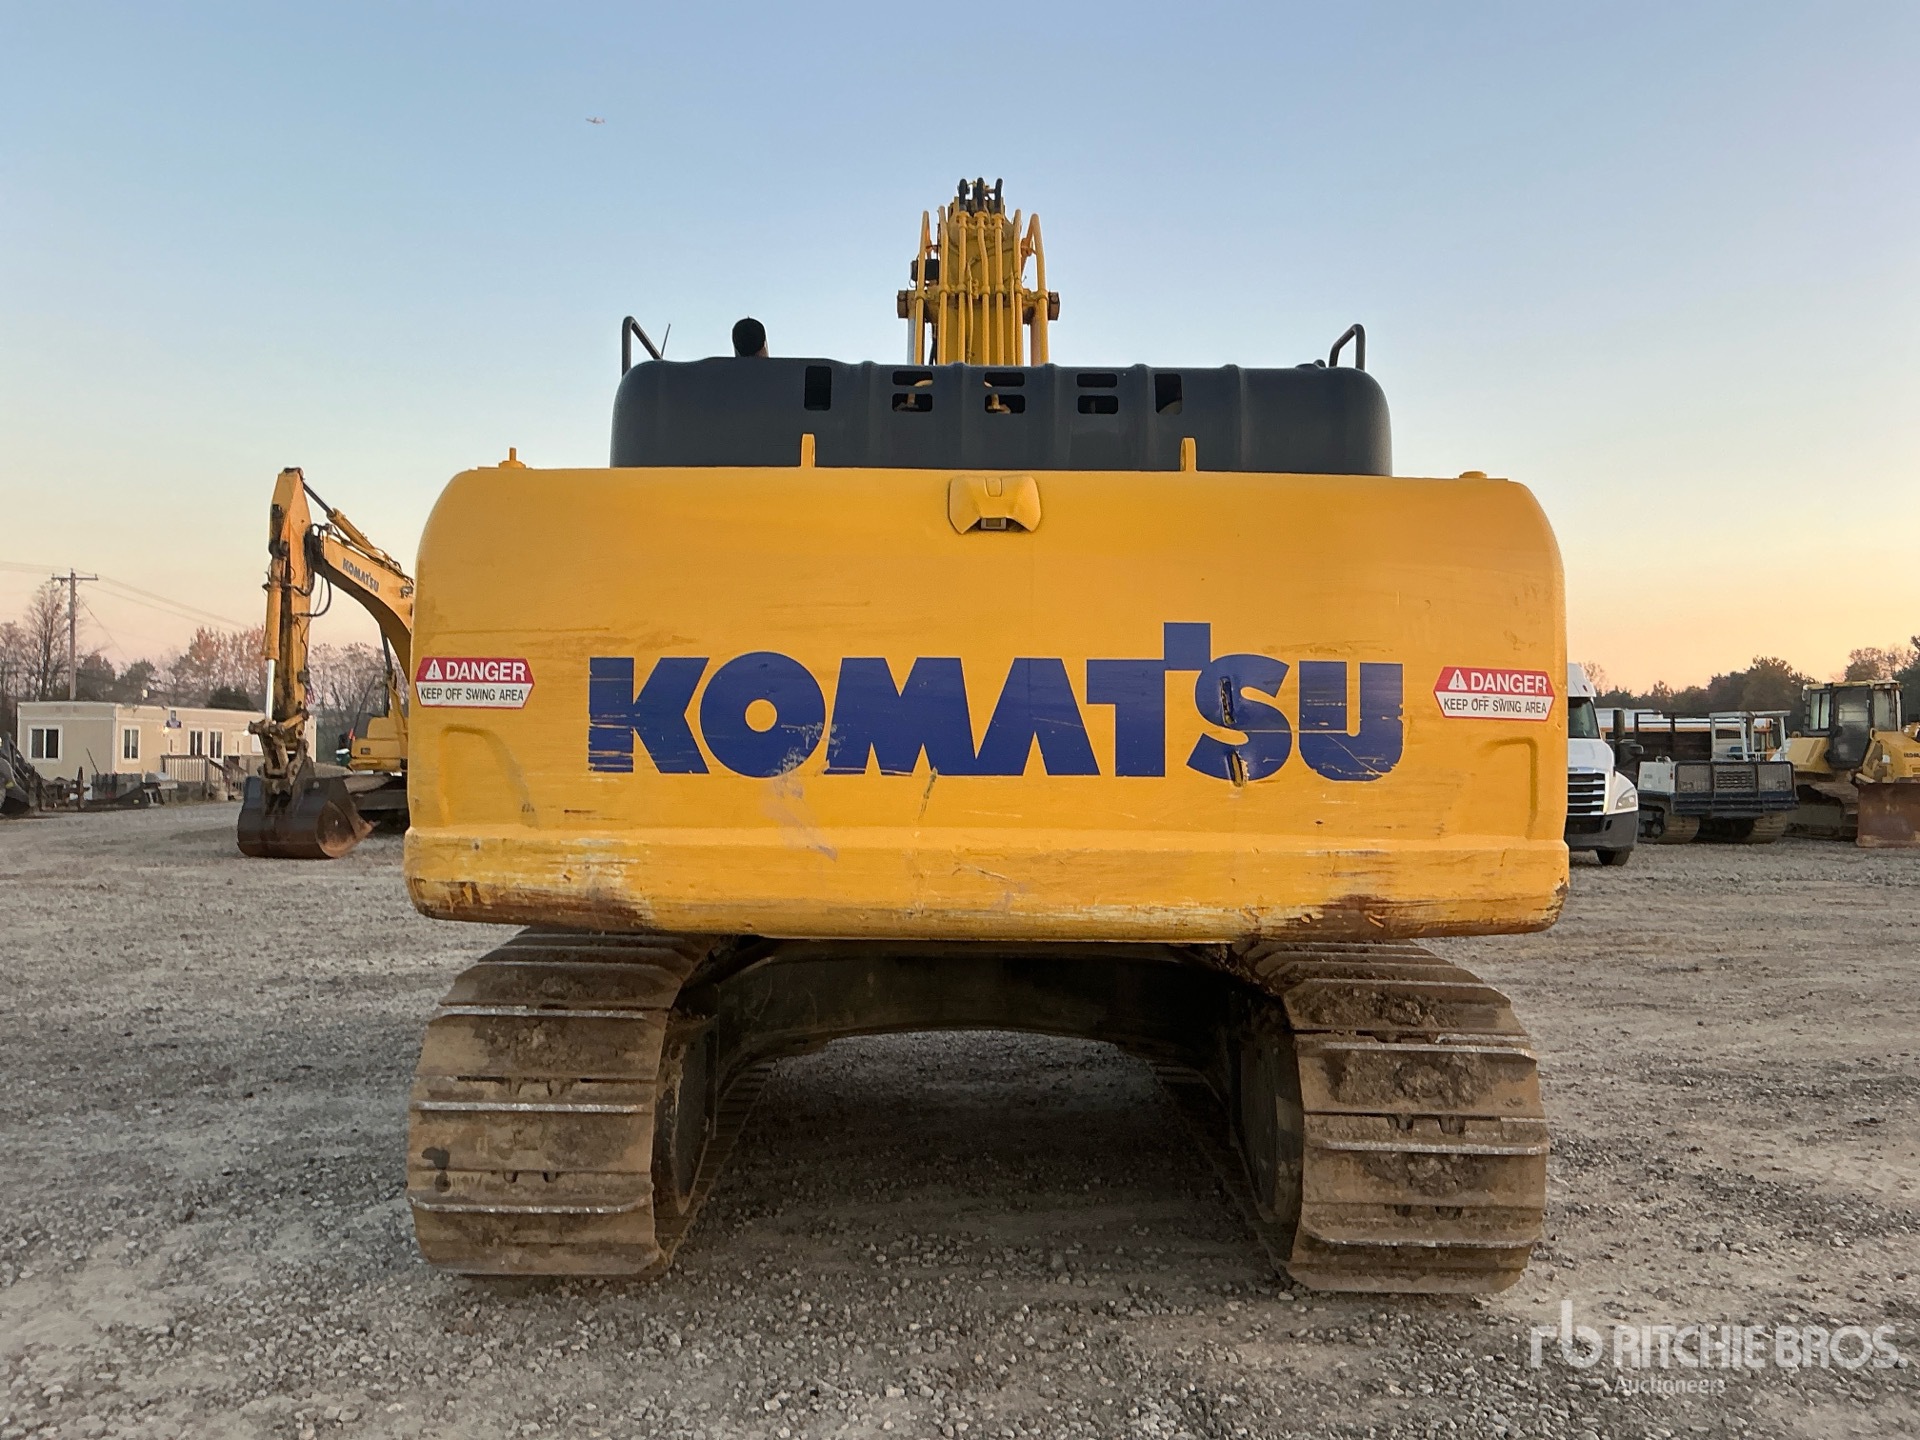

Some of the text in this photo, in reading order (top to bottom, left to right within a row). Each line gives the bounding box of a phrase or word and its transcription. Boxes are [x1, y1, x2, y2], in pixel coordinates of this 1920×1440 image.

[342, 557, 380, 593] KOMATSU
[446, 661, 526, 681] DANGER
[1470, 672, 1547, 694] DANGER
[421, 688, 524, 701] KEEP OFF SWING AREA
[588, 622, 1404, 784] KOMATSU
[1443, 698, 1547, 714] KEEP OFF SWING AREA
